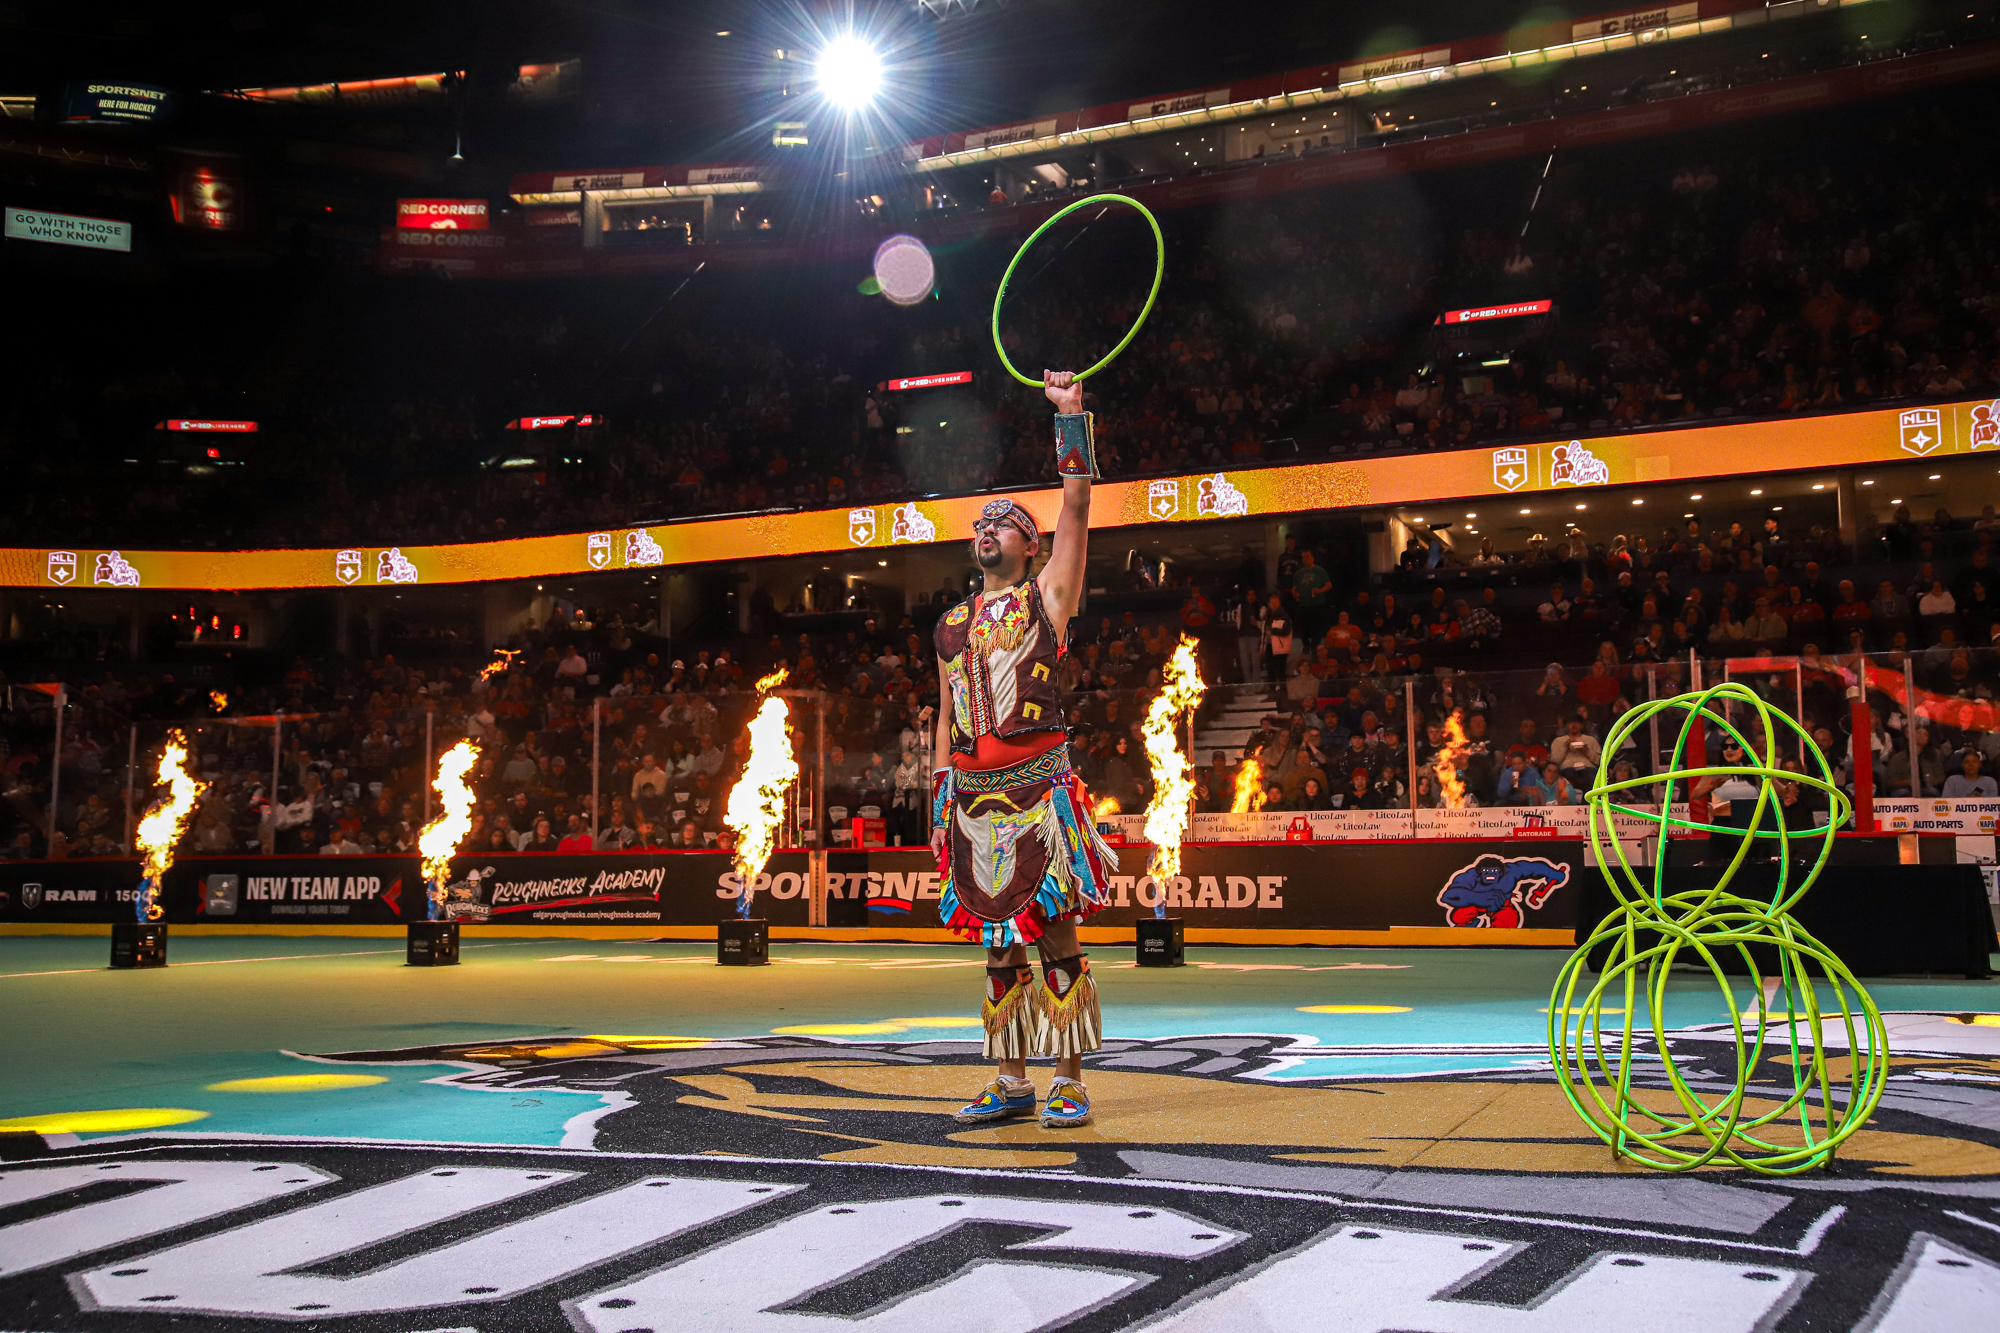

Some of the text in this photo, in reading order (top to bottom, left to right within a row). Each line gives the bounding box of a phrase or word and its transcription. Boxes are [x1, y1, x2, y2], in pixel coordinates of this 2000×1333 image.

[1363, 59, 1424, 78] WRANGLERS
[87, 84, 167, 100] SPORTSNET
[99, 99, 156, 113] HERE FOR HOCKEY
[400, 203, 486, 215] RED CORNER
[15, 214, 122, 236] GO WITH THOSE
[29, 226, 108, 244] WHO KNOW
[398, 232, 505, 248] RED CORNER
[1480, 308, 1497, 317] RED
[1497, 306, 1517, 314] LIVES
[1518, 304, 1538, 312] HERE
[916, 378, 929, 386] RED
[1904, 412, 1937, 425] NLL
[1497, 451, 1524, 463] NLL
[1571, 469, 1600, 483] Matters
[1151, 483, 1176, 494] NLL
[51, 553, 74, 563] NLL
[1443, 810, 1483, 818] LitcoLaw
[1512, 808, 1553, 817] LitcoLaw
[1873, 804, 1919, 813] UTO PARTS
[1934, 803, 2000, 813] NAPA AUTO PART
[1246, 814, 1283, 822] LitcoLaw
[1375, 811, 1414, 819] LitcoLaw
[1343, 822, 1381, 831] LitcoLaw
[1478, 820, 1518, 829] LitcoLaw
[1548, 818, 1590, 827] LitcoLaw
[1892, 820, 1964, 829] NAPA AUTO PARTS
[1980, 820, 1995, 828] NAPA
[247, 876, 381, 900] NEW TEAM APP
[492, 866, 666, 904] ROUGHNECKS ACADEMY
[716, 871, 940, 902] SPORTSNE
[45, 889, 97, 902] RAM
[1104, 875, 1283, 909] TORADE
[271, 904, 350, 914] DOWNLOAD YOURS TODAY
[446, 901, 490, 919] ROUGHNECKS
[532, 910, 662, 921] calgaryroughnecks.com/roughnecks-academy
